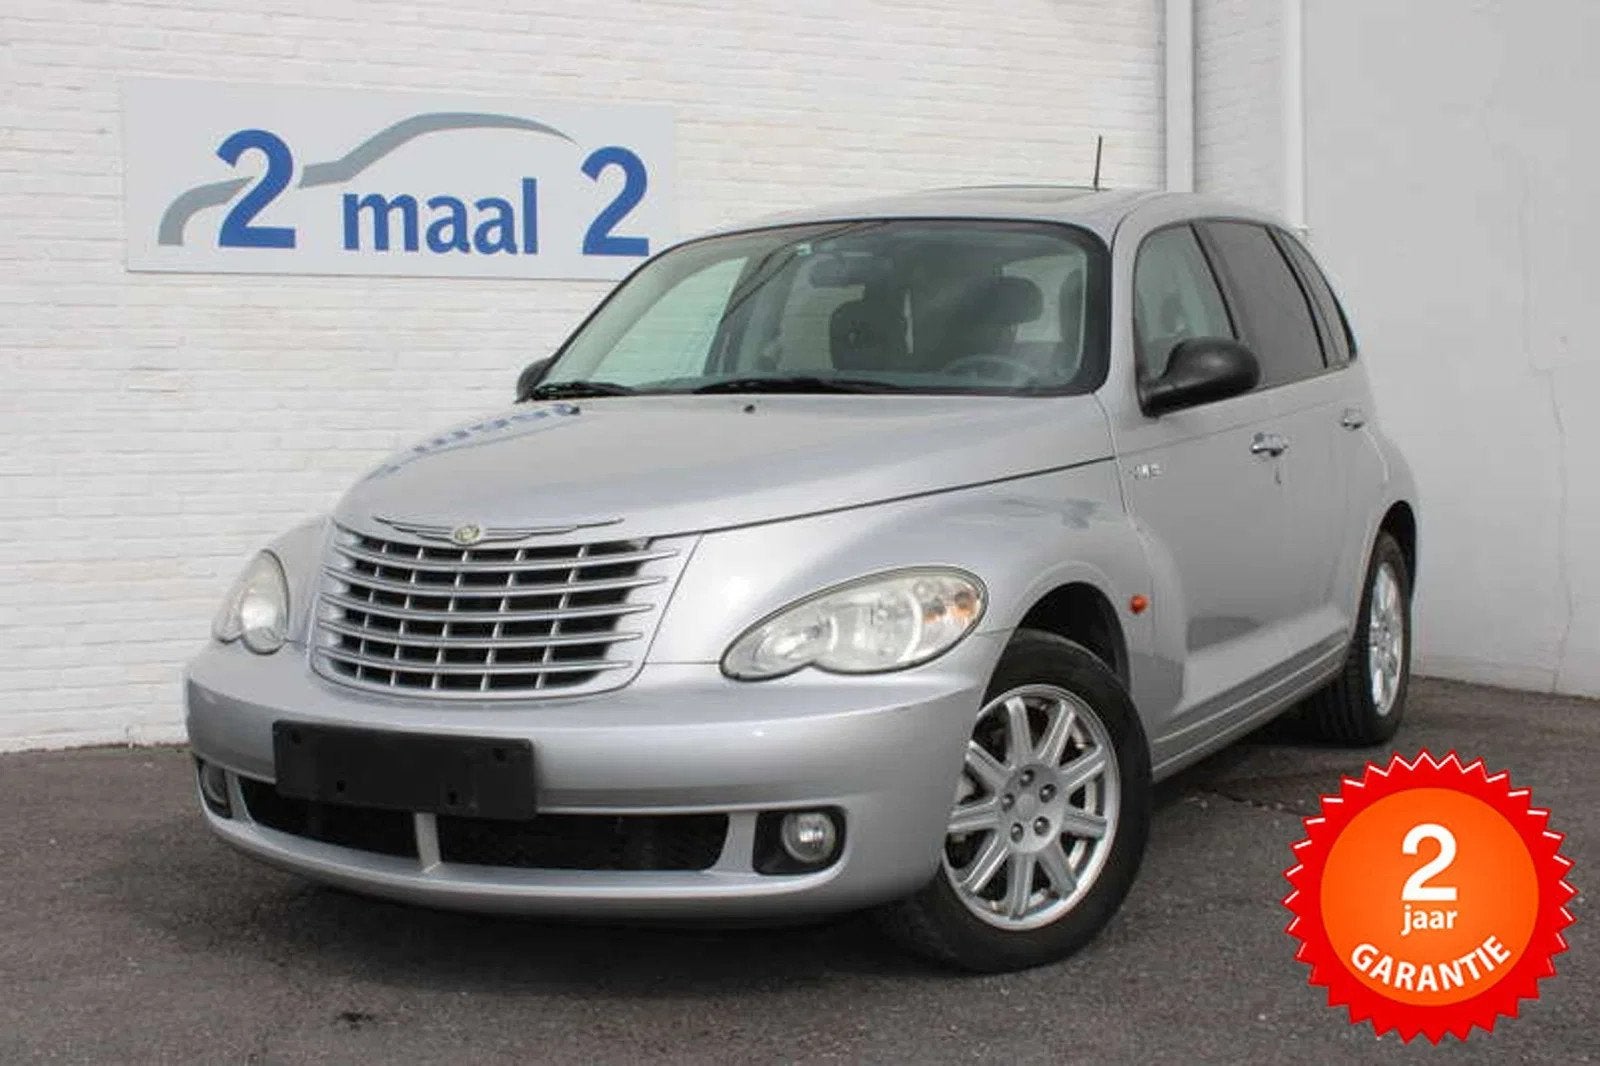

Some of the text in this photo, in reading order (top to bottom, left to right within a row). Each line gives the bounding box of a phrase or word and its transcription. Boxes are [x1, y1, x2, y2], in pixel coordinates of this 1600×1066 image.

[215, 128, 650, 257] 2 maal 2
